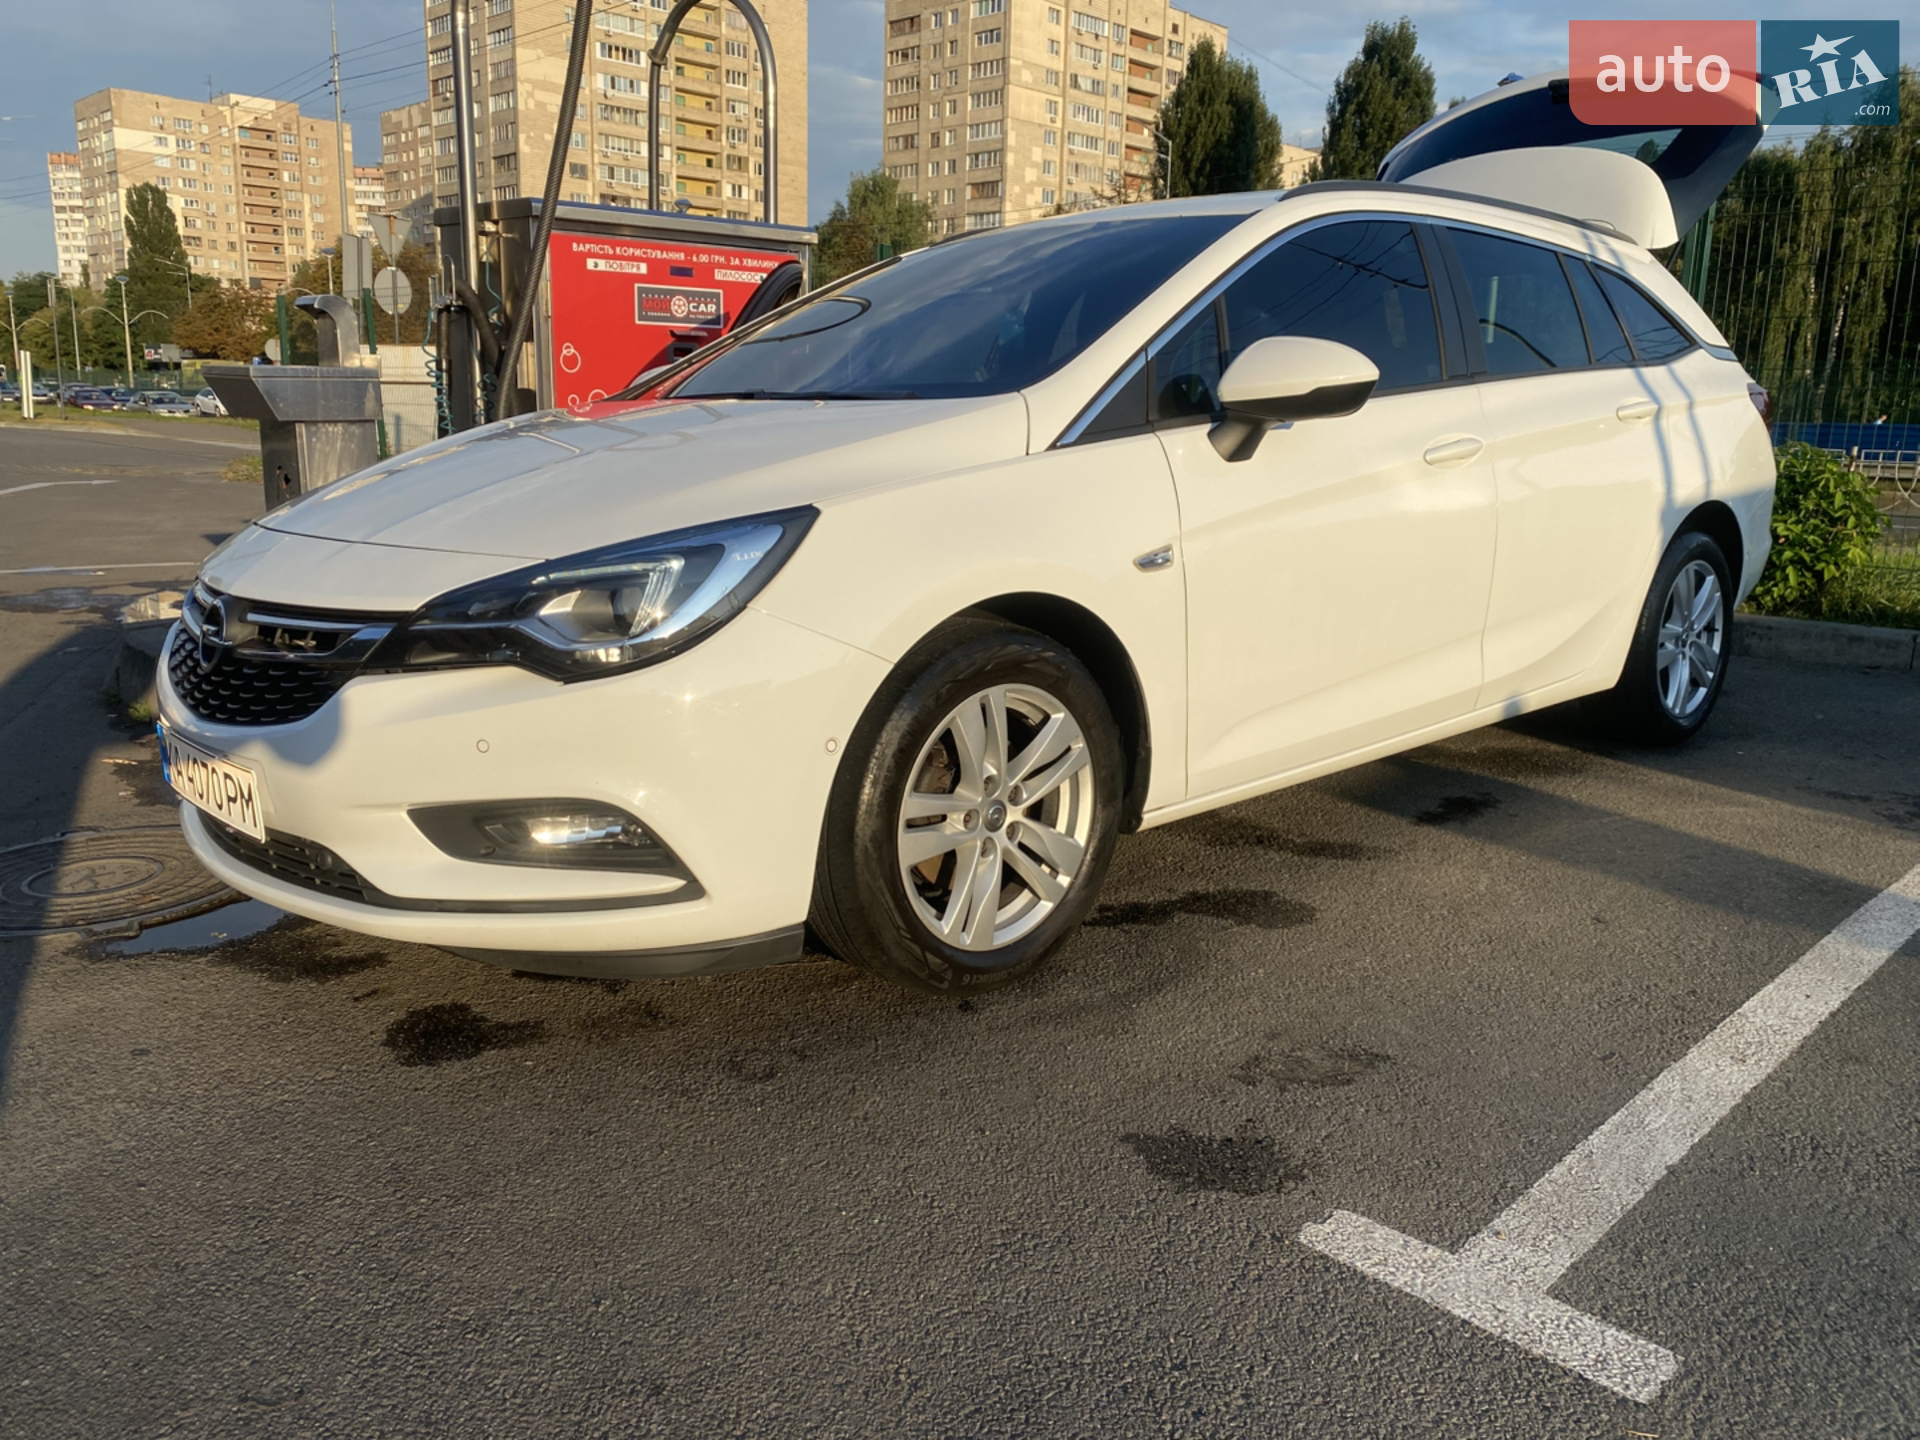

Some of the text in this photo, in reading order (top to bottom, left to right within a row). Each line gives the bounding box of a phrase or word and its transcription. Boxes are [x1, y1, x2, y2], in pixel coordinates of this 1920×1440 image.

[572, 242, 614, 255] ВАРТІСТЬ
[615, 245, 685, 261] КОРИСТУВАННЯ
[691, 253, 709, 263] 6,00
[711, 255, 727, 264] ГРН.
[729, 256, 740, 266] ЗА
[604, 260, 641, 272] ПОВІТРЯ
[716, 270, 760, 282] ПИЛОСОС
[688, 303, 717, 313] CAR
